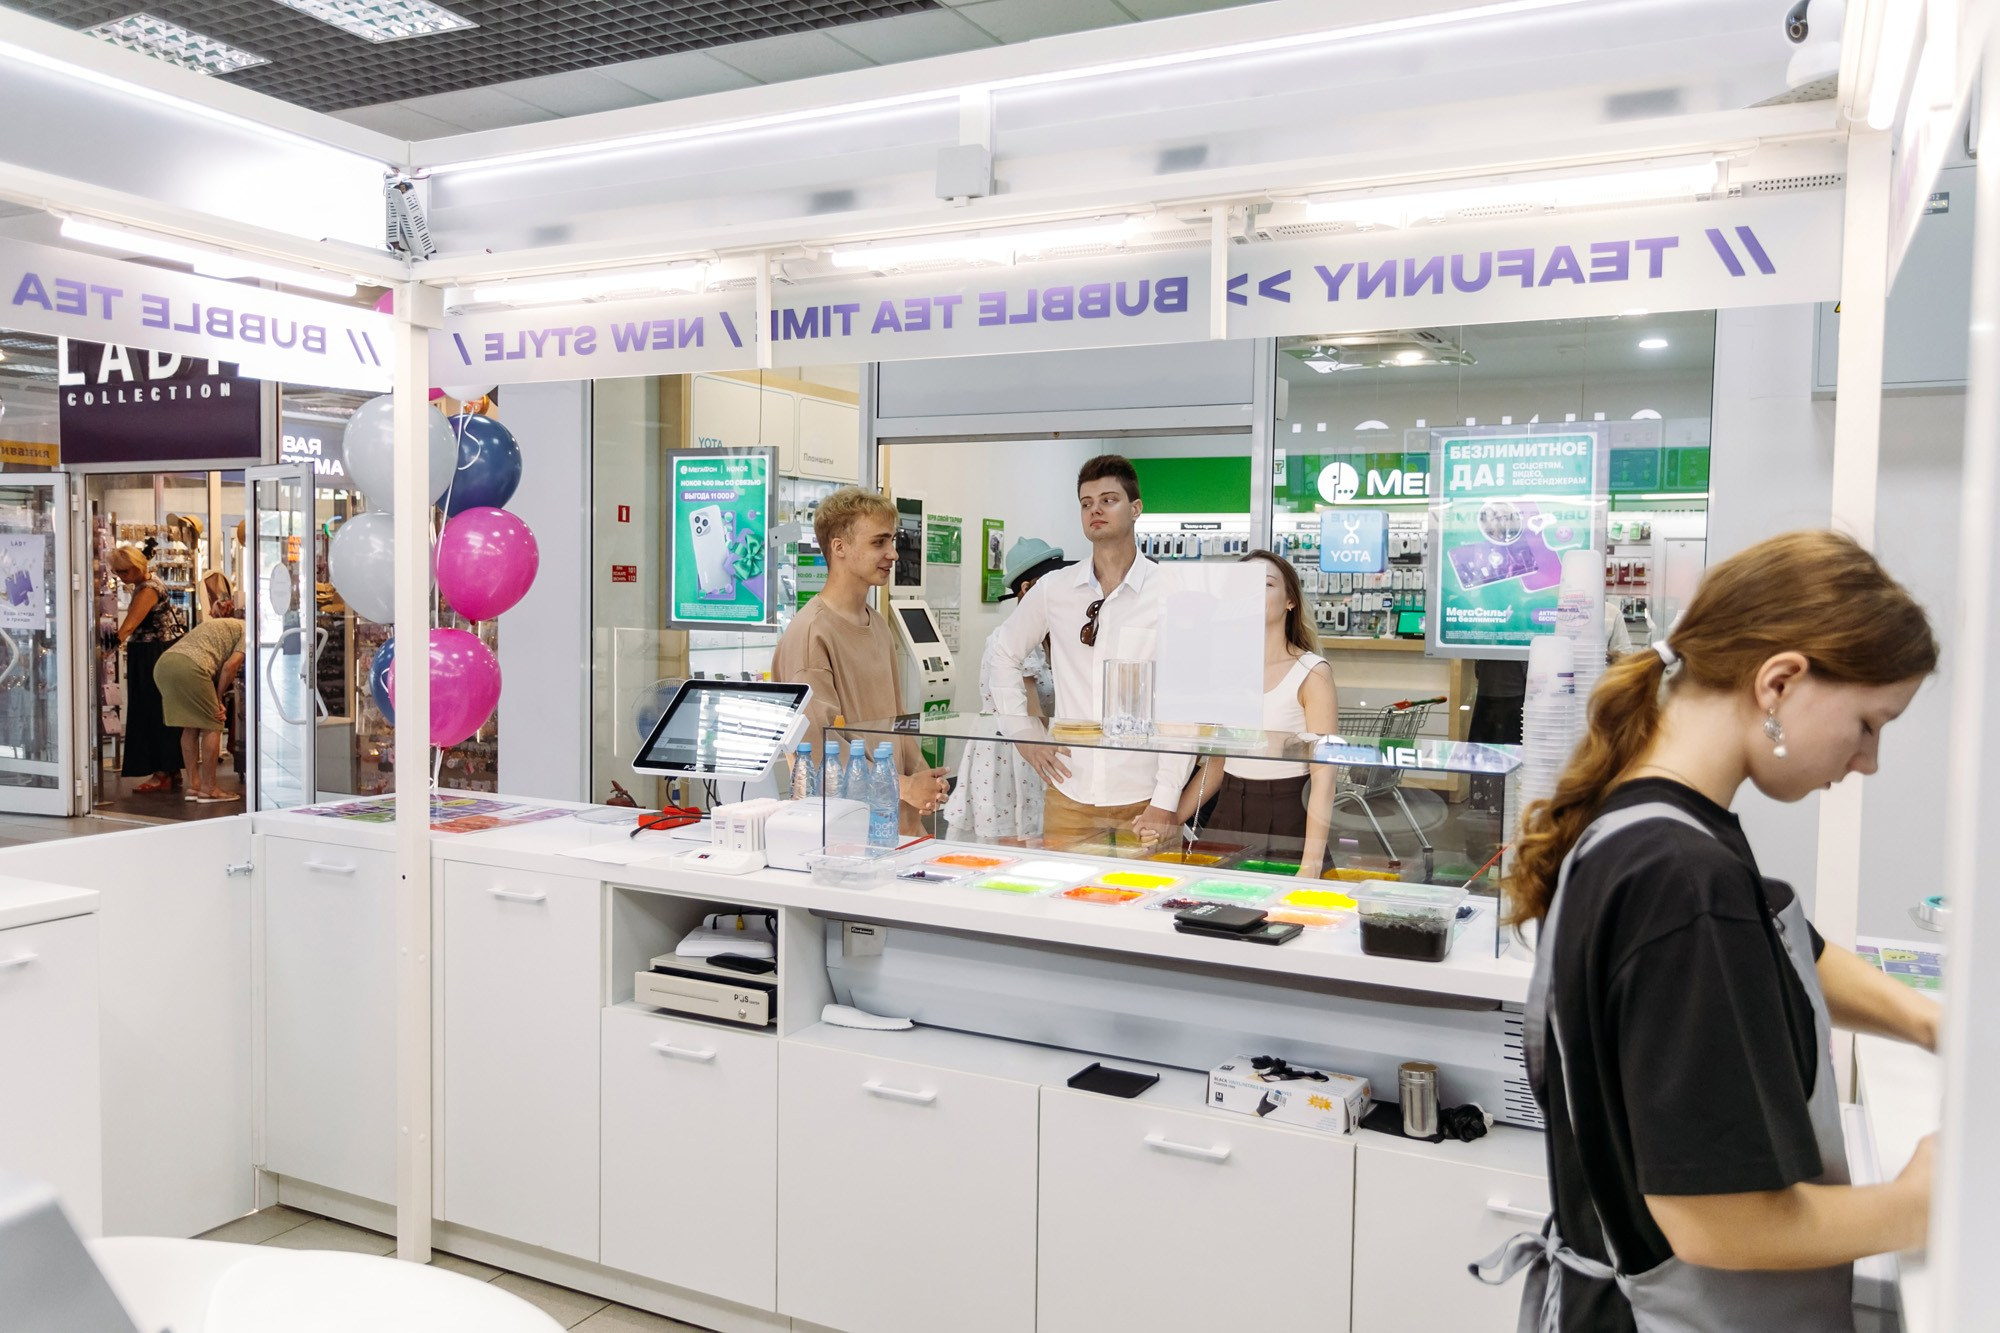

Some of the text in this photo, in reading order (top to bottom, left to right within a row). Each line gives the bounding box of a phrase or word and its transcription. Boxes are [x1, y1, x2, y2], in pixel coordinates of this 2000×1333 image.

[67, 383, 231, 407] COLLECTION
[1450, 442, 1587, 460] БЕЗЛИМИТНОЕ
[803, 453, 834, 465] Планшеты
[1512, 462, 1564, 471] СОЦСЕТЯМ,
[1450, 463, 1505, 491] ДА!
[1512, 470, 1543, 479] ВИДЕО,
[1512, 477, 1587, 486] МЕССЕНДЖЕРАМ
[684, 492, 710, 501] ВЫГОДА
[1330, 550, 1372, 563] YOTA
[1446, 607, 1507, 617] МегаСилы
